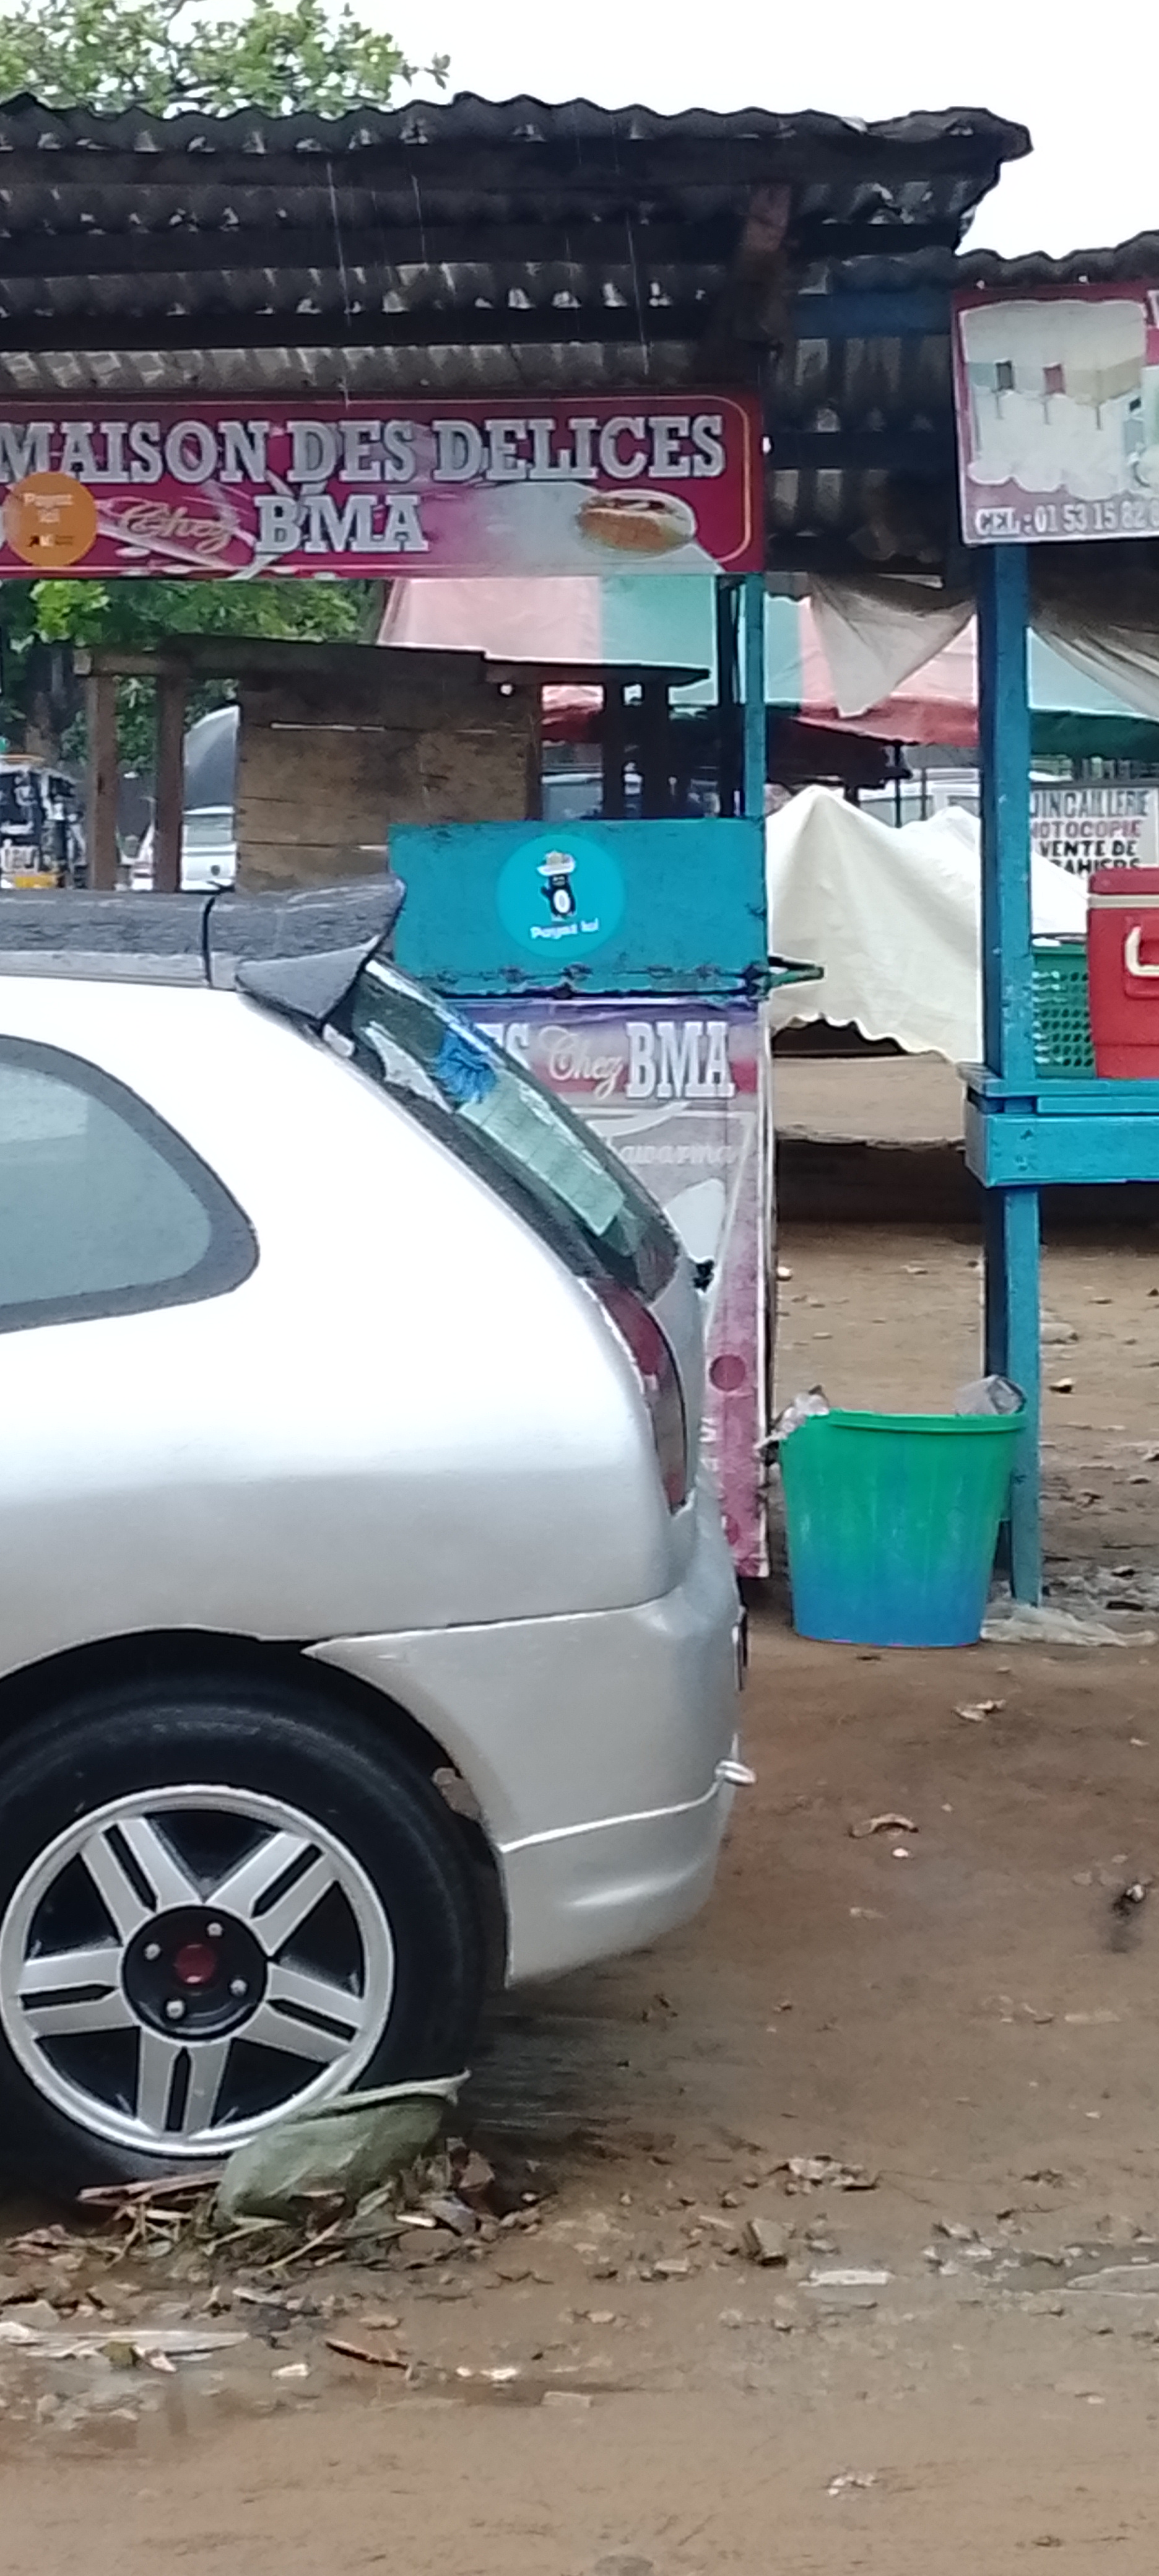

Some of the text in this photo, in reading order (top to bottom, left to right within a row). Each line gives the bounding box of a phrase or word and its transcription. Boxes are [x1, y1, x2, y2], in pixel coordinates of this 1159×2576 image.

[0, 415, 726, 484] MAISON DES DELICES
[99, 494, 430, 554] Chez BMA
[1063, 503, 1087, 531] 53
[1093, 502, 1116, 530] 15
[1040, 840, 1136, 858] VENTE DE
[539, 1025, 623, 1100] Chez
[625, 1020, 736, 1099] BMA
